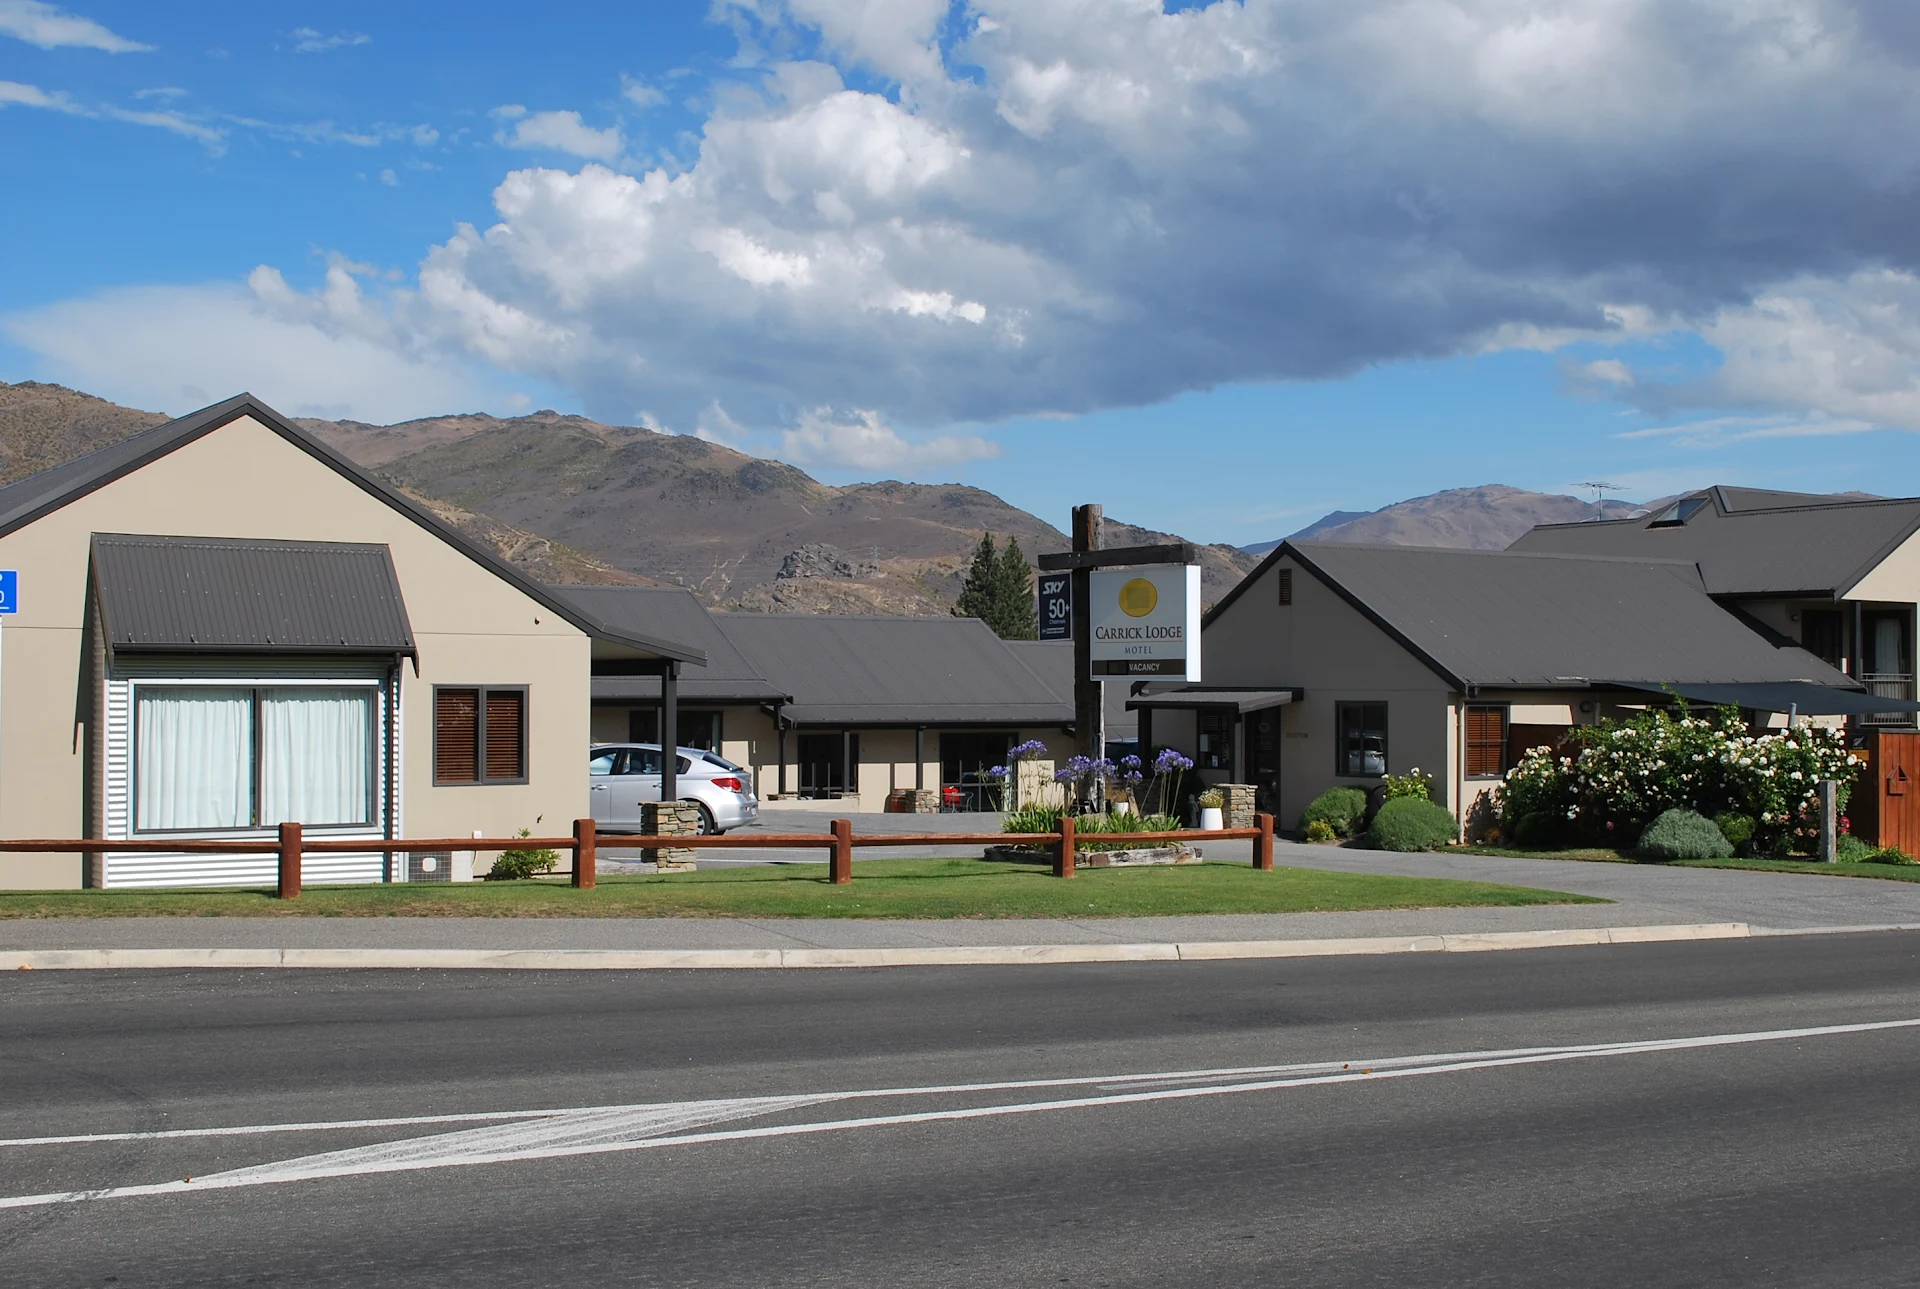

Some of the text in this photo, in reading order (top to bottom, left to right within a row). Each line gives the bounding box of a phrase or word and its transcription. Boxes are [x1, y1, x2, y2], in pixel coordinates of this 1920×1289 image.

[1043, 580, 1065, 595] SKY
[1048, 598, 1070, 619] 50+
[1095, 625, 1182, 639] CARRICK LODGE
[1124, 646, 1152, 654] MOTEL
[1129, 662, 1160, 671] VACANCY
